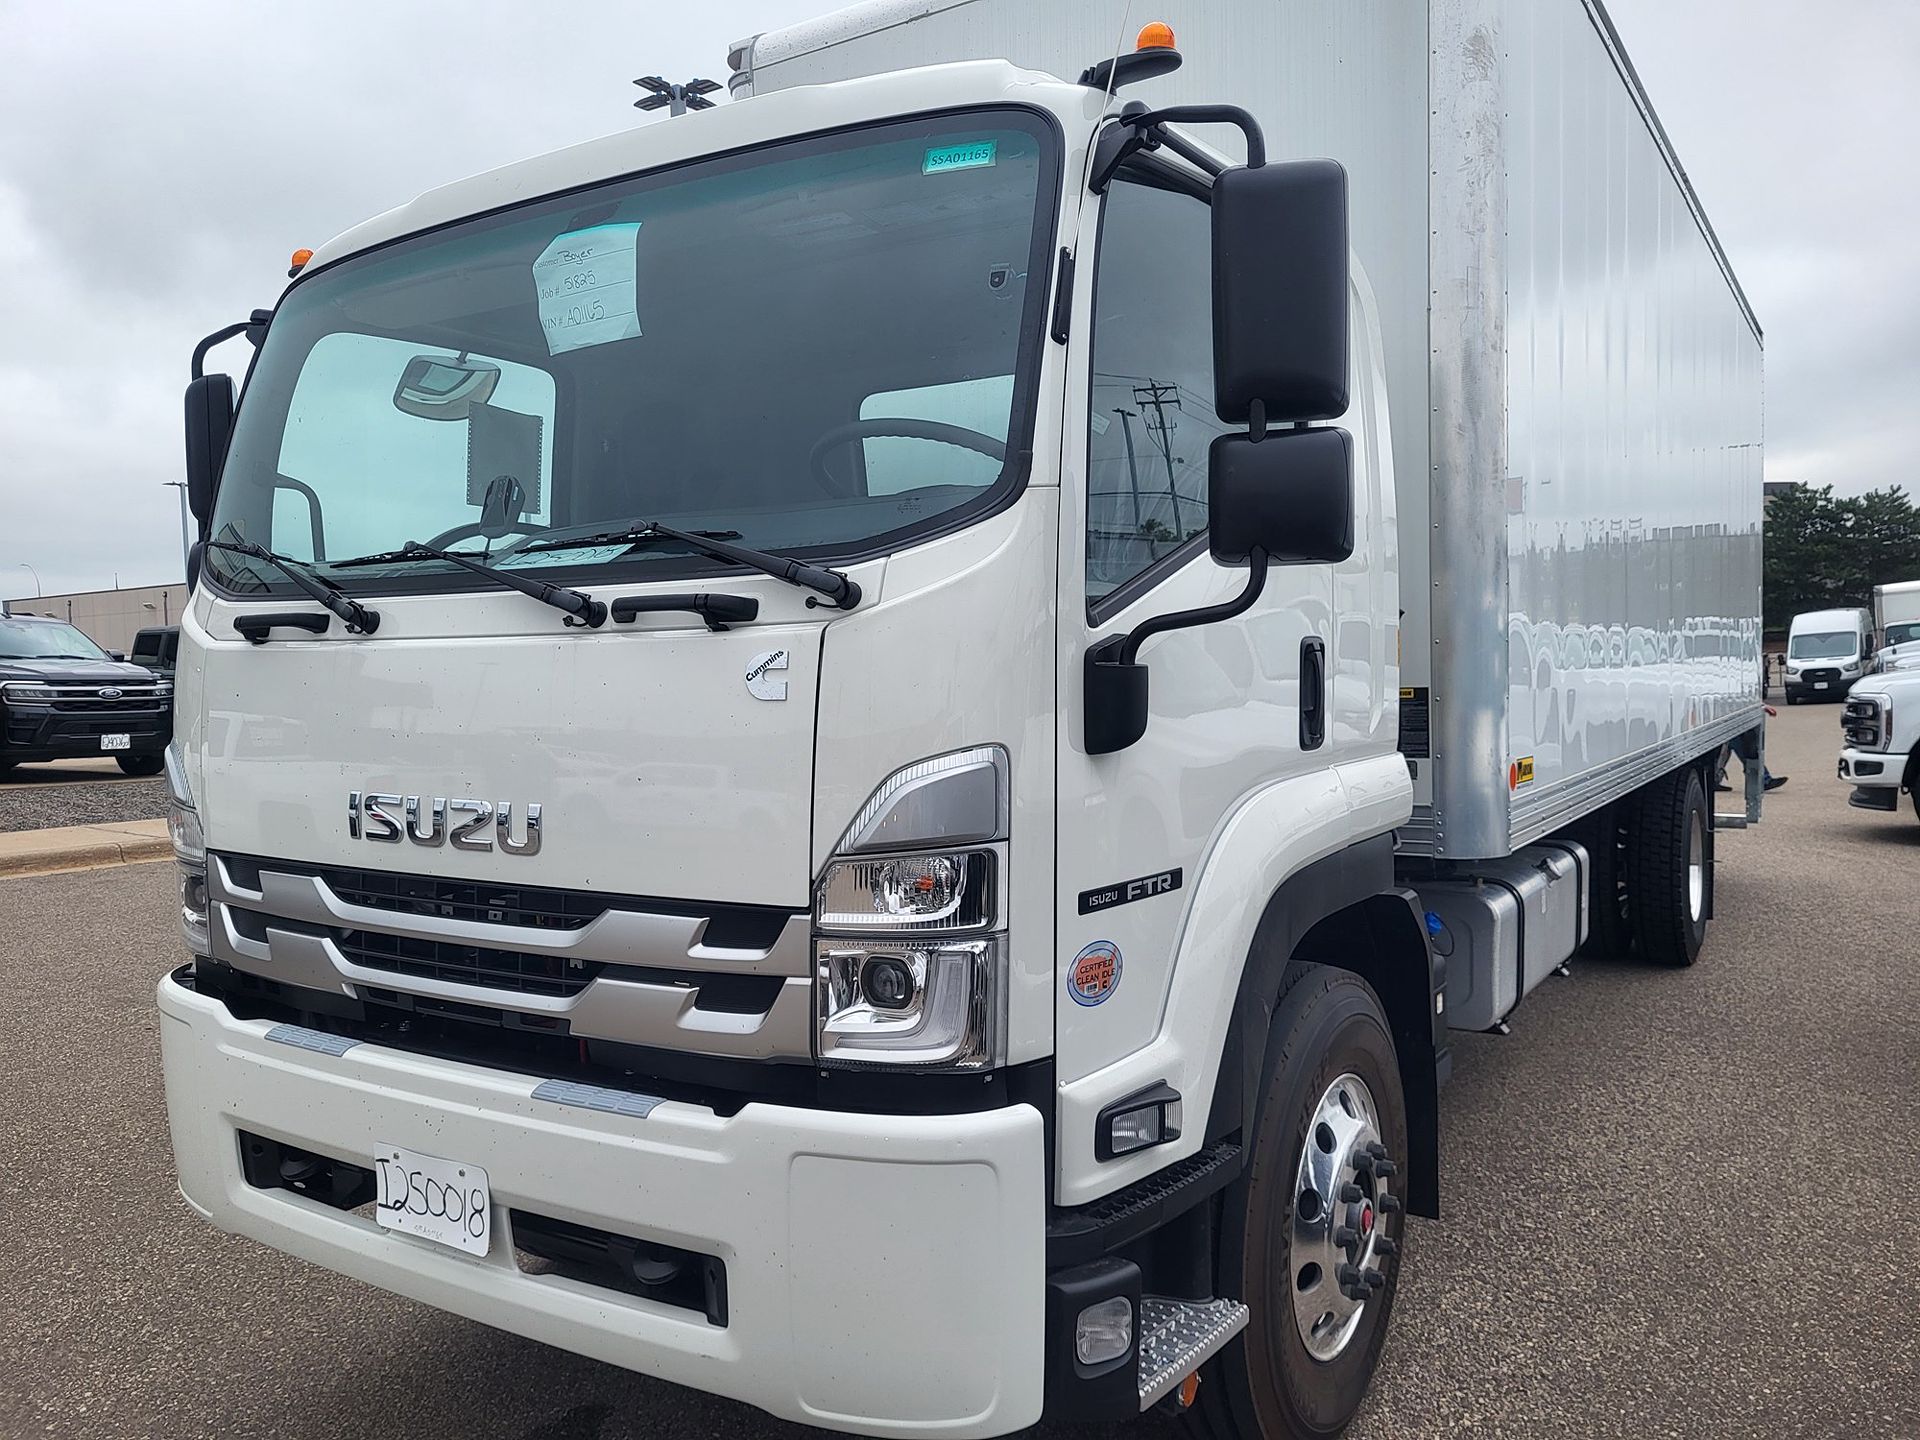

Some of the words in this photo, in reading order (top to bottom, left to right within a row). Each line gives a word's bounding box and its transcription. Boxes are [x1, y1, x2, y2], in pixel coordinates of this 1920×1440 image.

[930, 149, 989, 166] SSA01165
[557, 248, 593, 265] Boyer
[540, 287, 554, 300] Job
[542, 318, 557, 330] VIN
[745, 650, 784, 682] Cummins
[349, 790, 543, 856] ISUZU
[1089, 890, 1119, 907] ISUZU
[1126, 873, 1173, 901] FTR
[1079, 958, 1114, 975] CERTIFIED
[1076, 973, 1100, 986] CLEAN
[1101, 967, 1117, 979] IDLE
